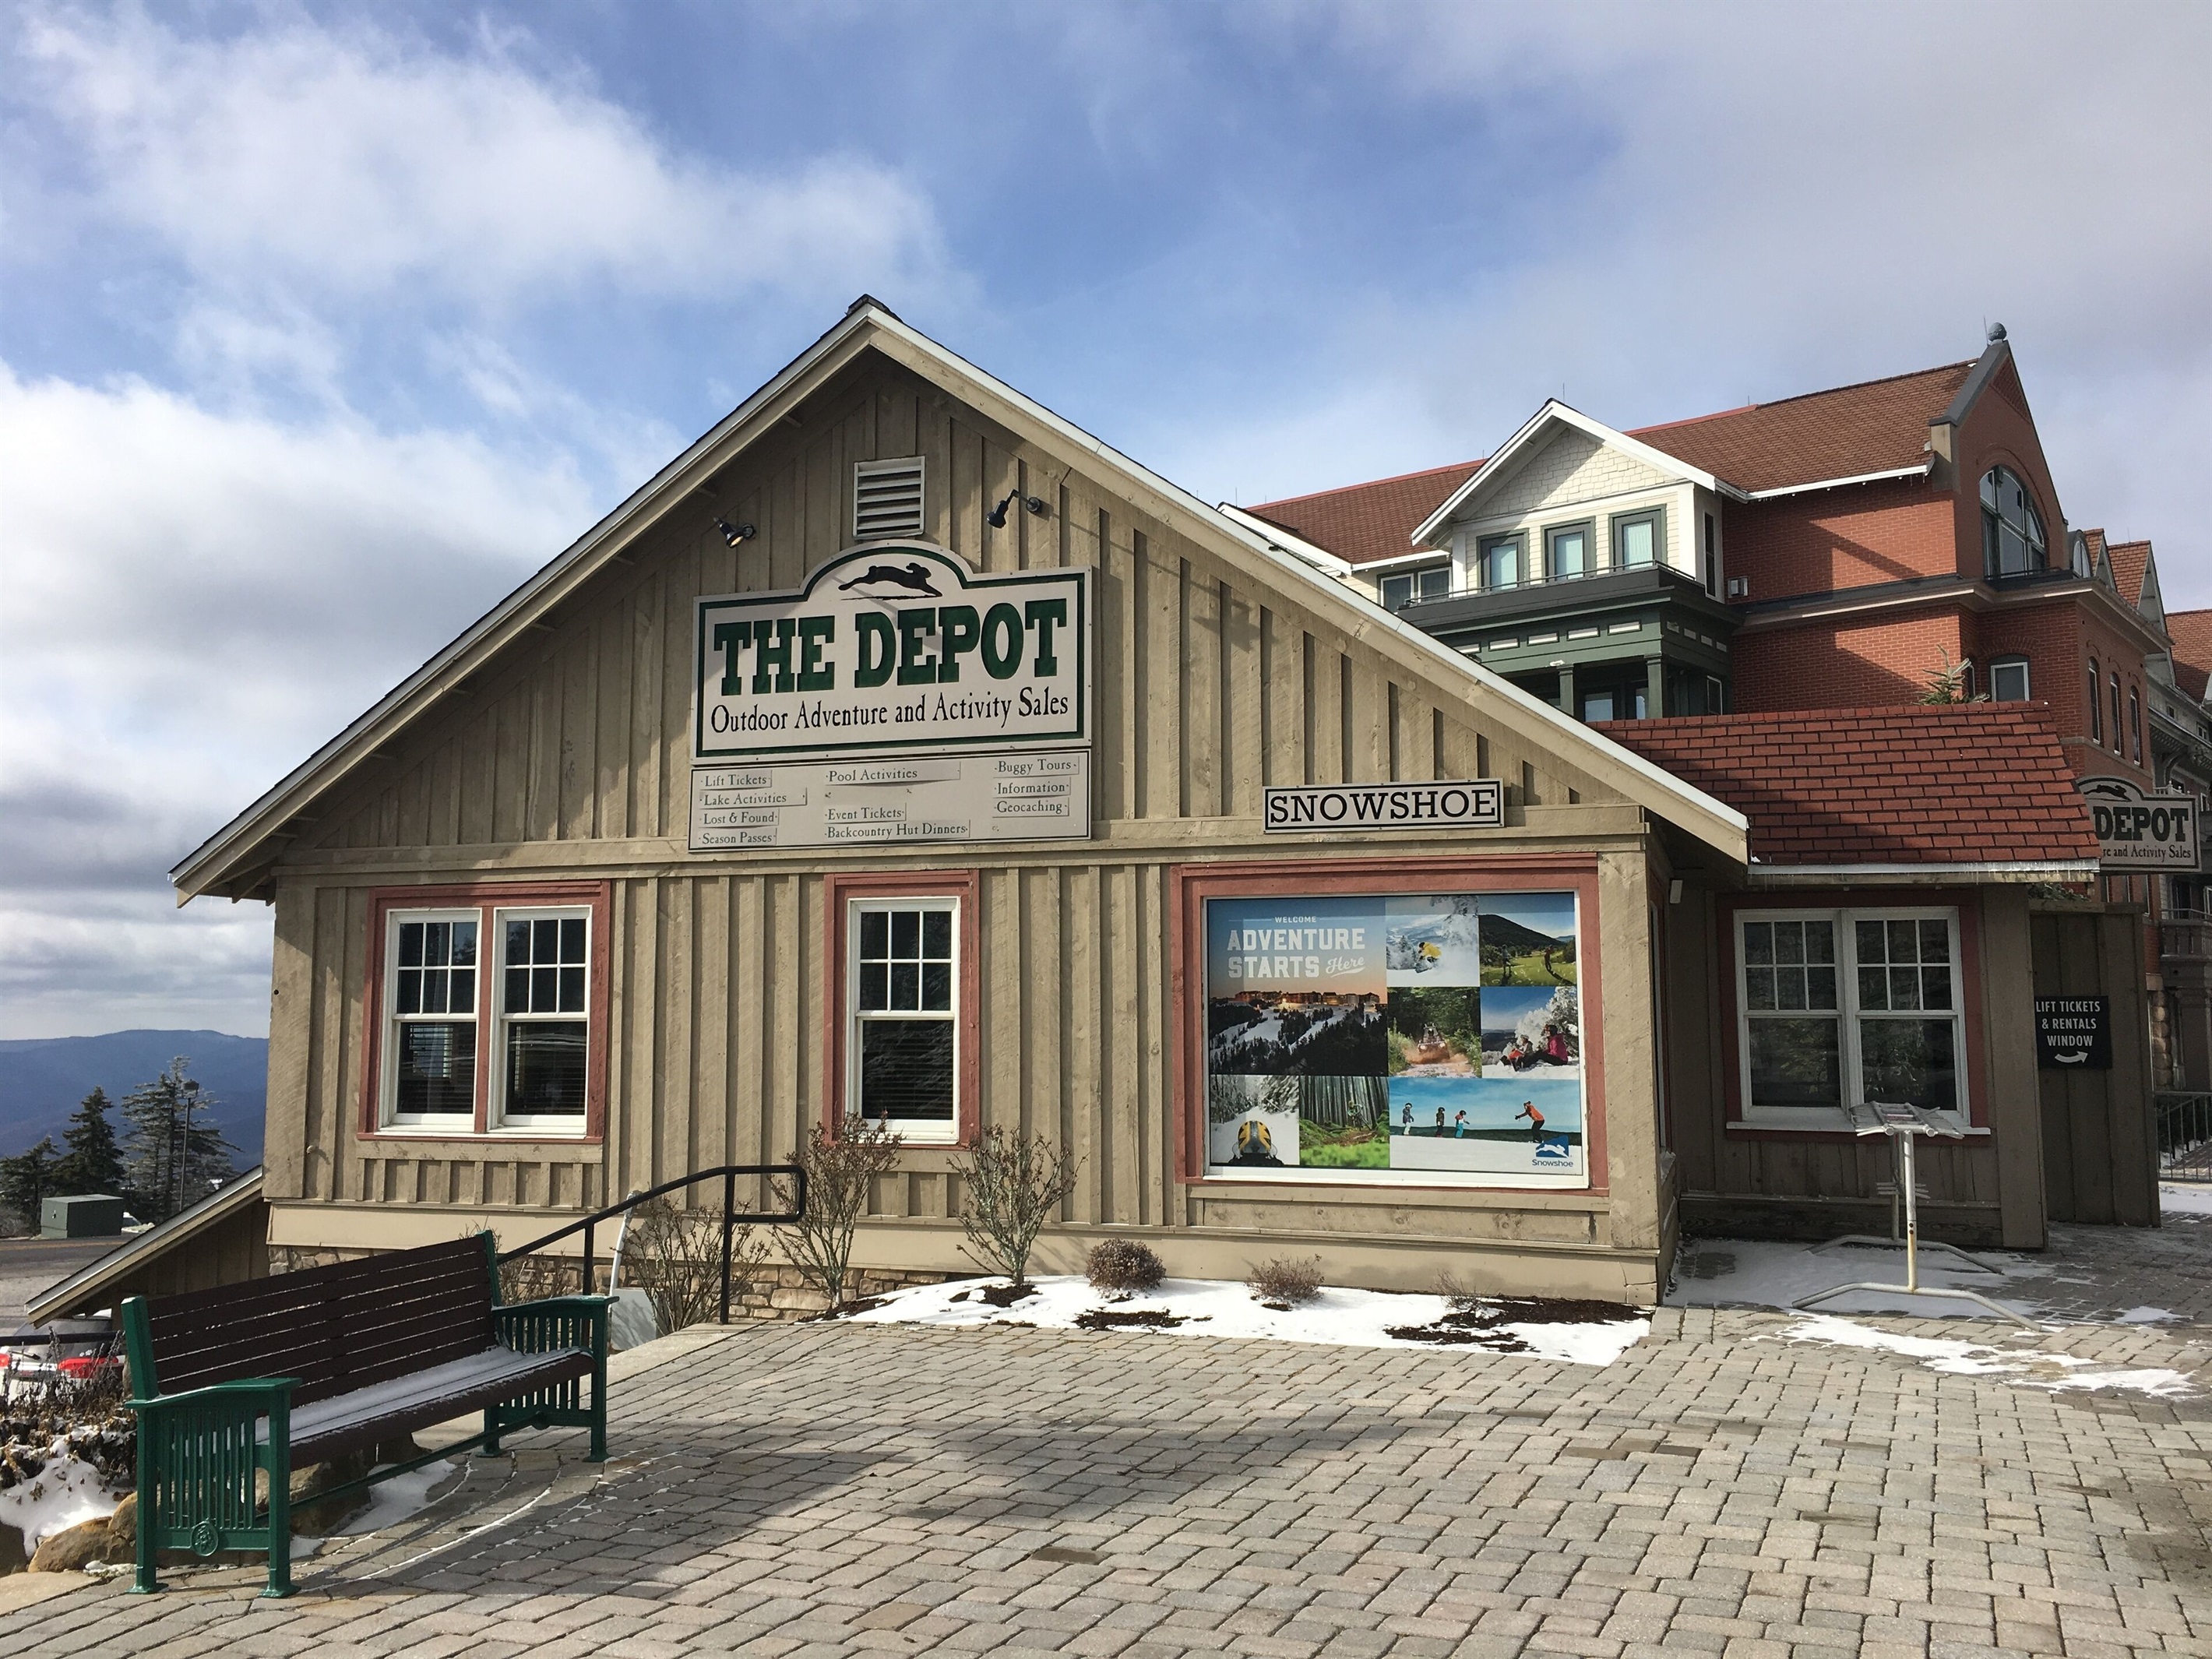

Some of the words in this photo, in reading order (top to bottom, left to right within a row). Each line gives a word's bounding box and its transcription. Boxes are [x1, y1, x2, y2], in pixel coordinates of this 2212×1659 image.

[713, 615, 835, 696] THE
[854, 597, 1067, 689] DEPOT
[710, 703, 788, 734] Outdoor
[794, 700, 888, 730] Adventure
[895, 693, 926, 724] and
[932, 690, 1012, 728] Activity
[1017, 686, 1069, 718] Sales
[998, 760, 1034, 775] Buggy
[1037, 759, 1071, 770] Tours
[705, 775, 724, 787] Lift
[728, 773, 767, 786] Tickets
[829, 770, 856, 782] Pool
[860, 768, 918, 780] Activities
[998, 781, 1065, 794] Information
[704, 794, 730, 805] Lake
[733, 792, 787, 805] Activities
[828, 809, 857, 820] Event
[861, 806, 902, 819] Tickets
[997, 800, 1062, 815] Geocaching
[1269, 787, 1496, 825] SNOWSHOE
[703, 813, 726, 825] Lost
[729, 812, 737, 823] &
[741, 811, 774, 823] Found
[2093, 805, 2189, 842] DEPOT
[703, 833, 736, 844] Season
[740, 831, 772, 844] Passes
[827, 824, 893, 840] Backcountry
[896, 823, 919, 836] Hut
[921, 822, 967, 835] Dinners
[2114, 844, 2128, 857] and
[2131, 844, 2166, 862] Activity
[2168, 844, 2191, 858] Sales
[1227, 928, 1365, 951] ADVENTURE
[1228, 956, 1319, 978] STARTS
[1326, 956, 1365, 975] Here
[2035, 1001, 2055, 1012] LIFT
[2059, 1001, 2101, 1012] TICKETS
[2041, 1018, 2049, 1029] &
[2052, 1018, 2097, 1029] RENTALS
[2047, 1035, 2093, 1046] WINDOW
